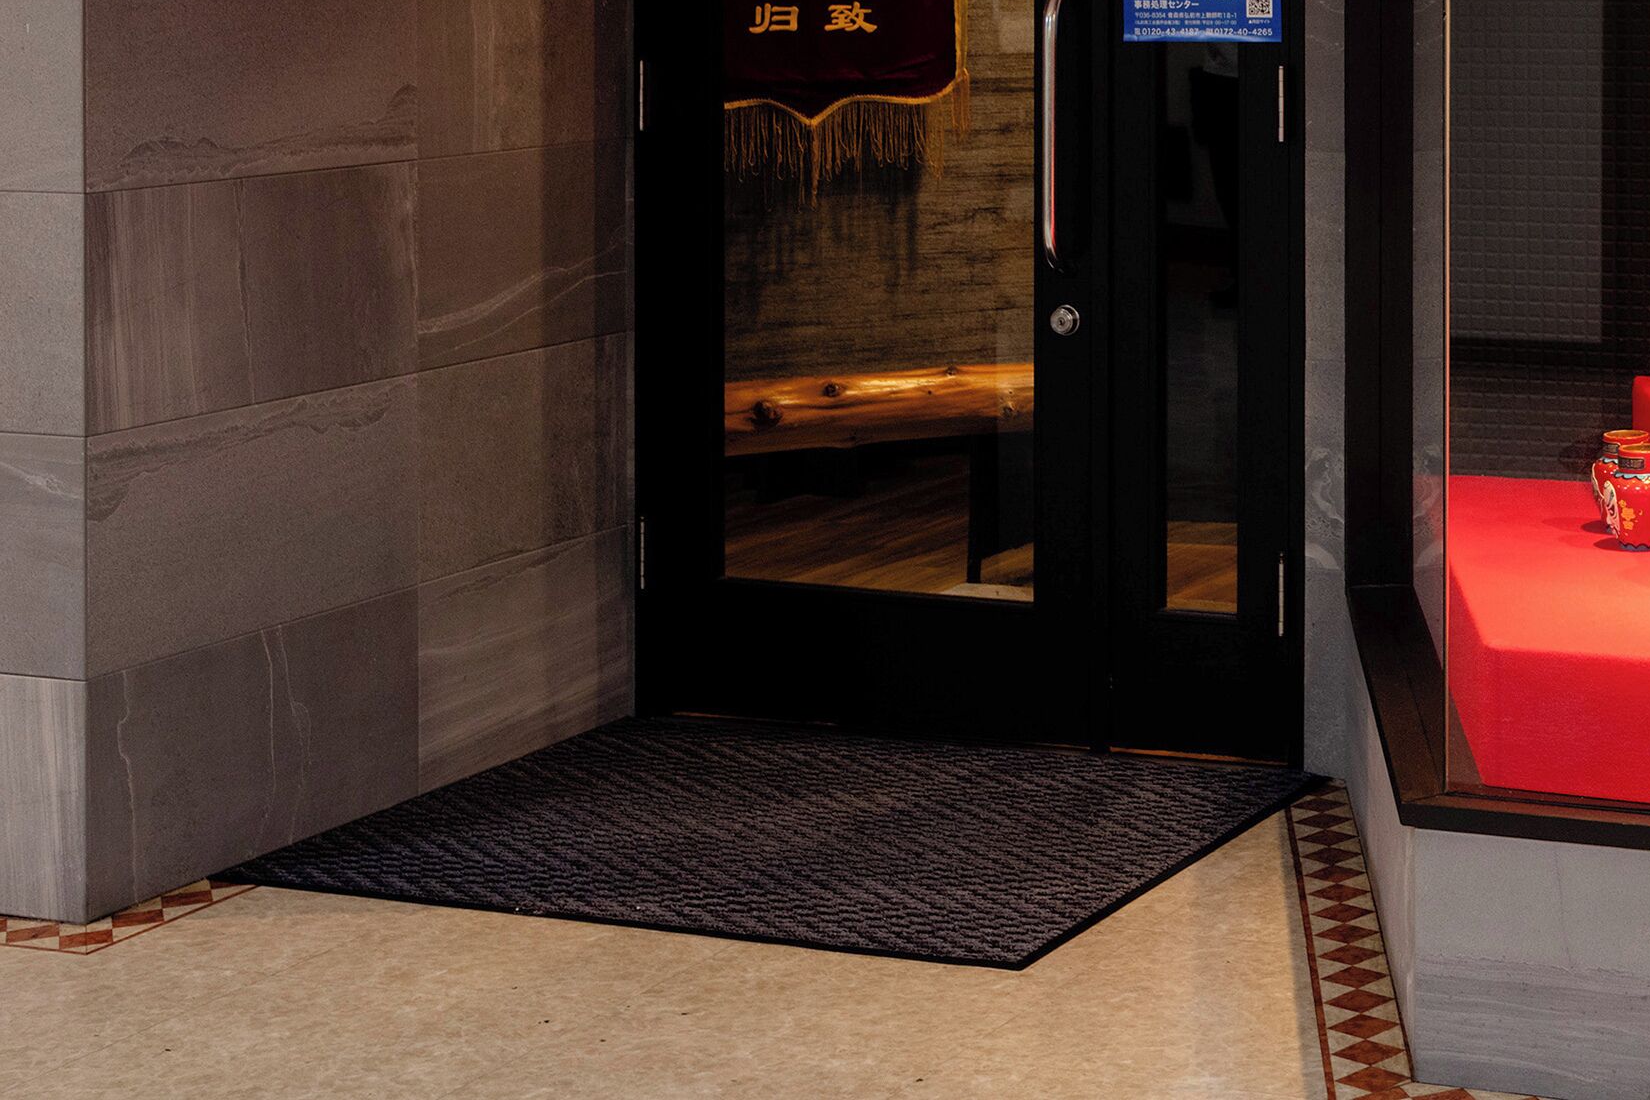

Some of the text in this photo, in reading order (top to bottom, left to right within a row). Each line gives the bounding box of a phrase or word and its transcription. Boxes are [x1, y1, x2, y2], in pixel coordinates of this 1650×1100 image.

[1134, 0, 1199, 9] 事務処理センター
